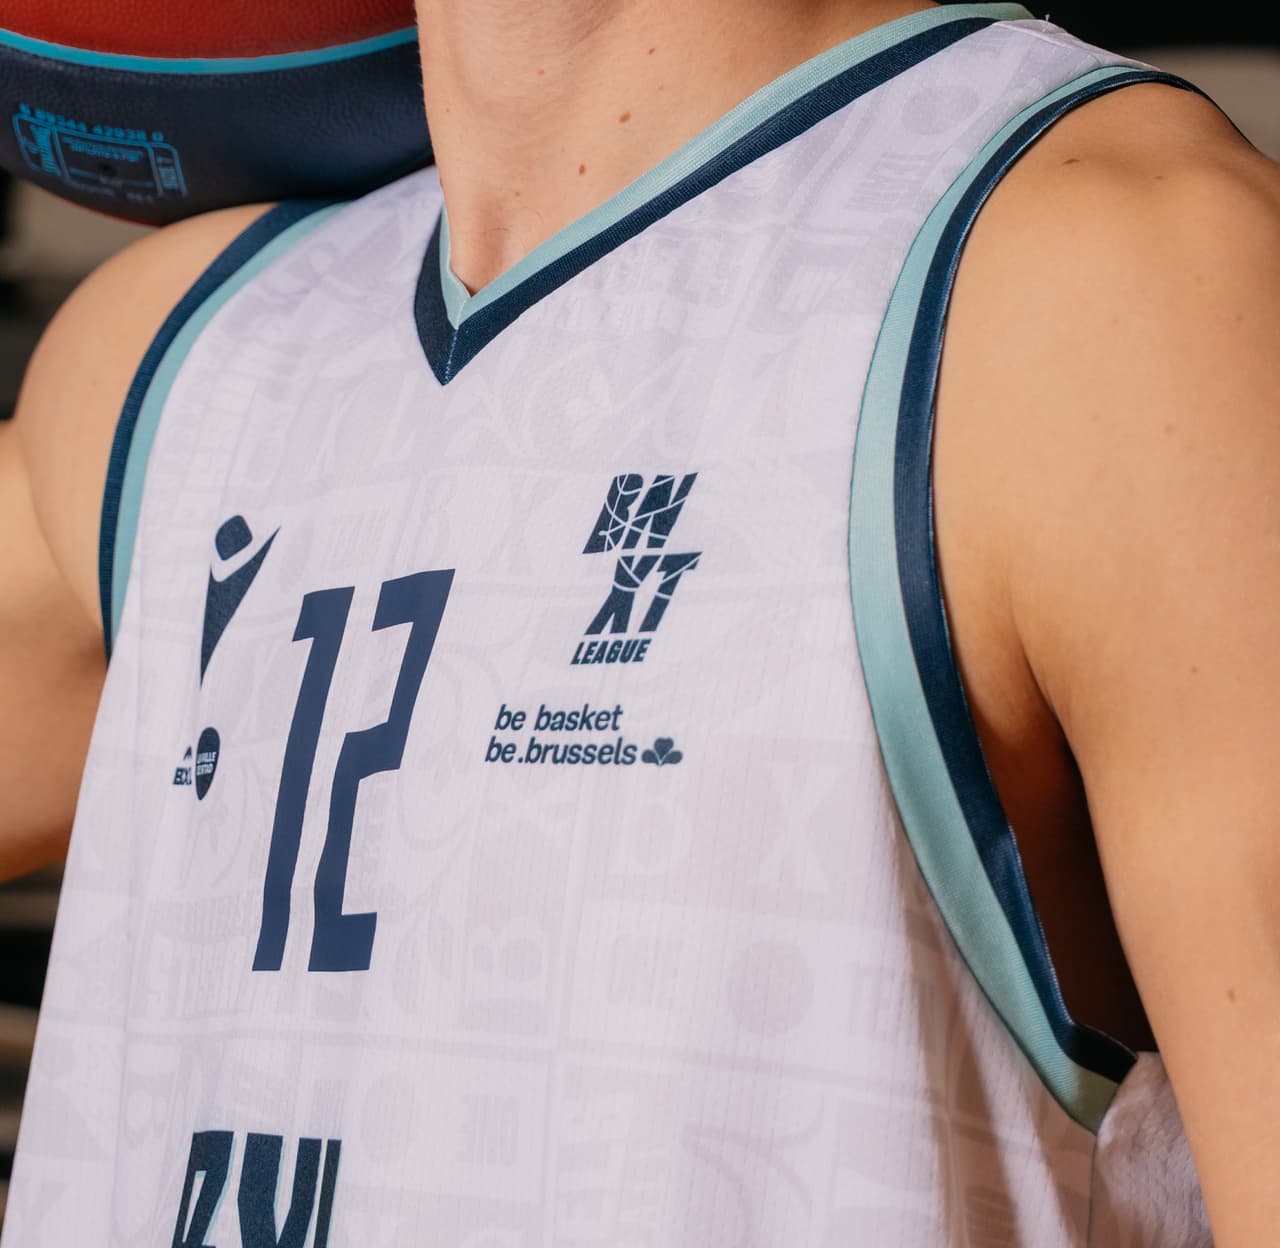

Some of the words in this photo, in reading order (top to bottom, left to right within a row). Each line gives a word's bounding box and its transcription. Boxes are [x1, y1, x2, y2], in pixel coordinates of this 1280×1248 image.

[570, 638, 652, 665] LEAGUE
[494, 703, 527, 731] be
[533, 703, 623, 731] basket
[251, 568, 456, 973] 12
